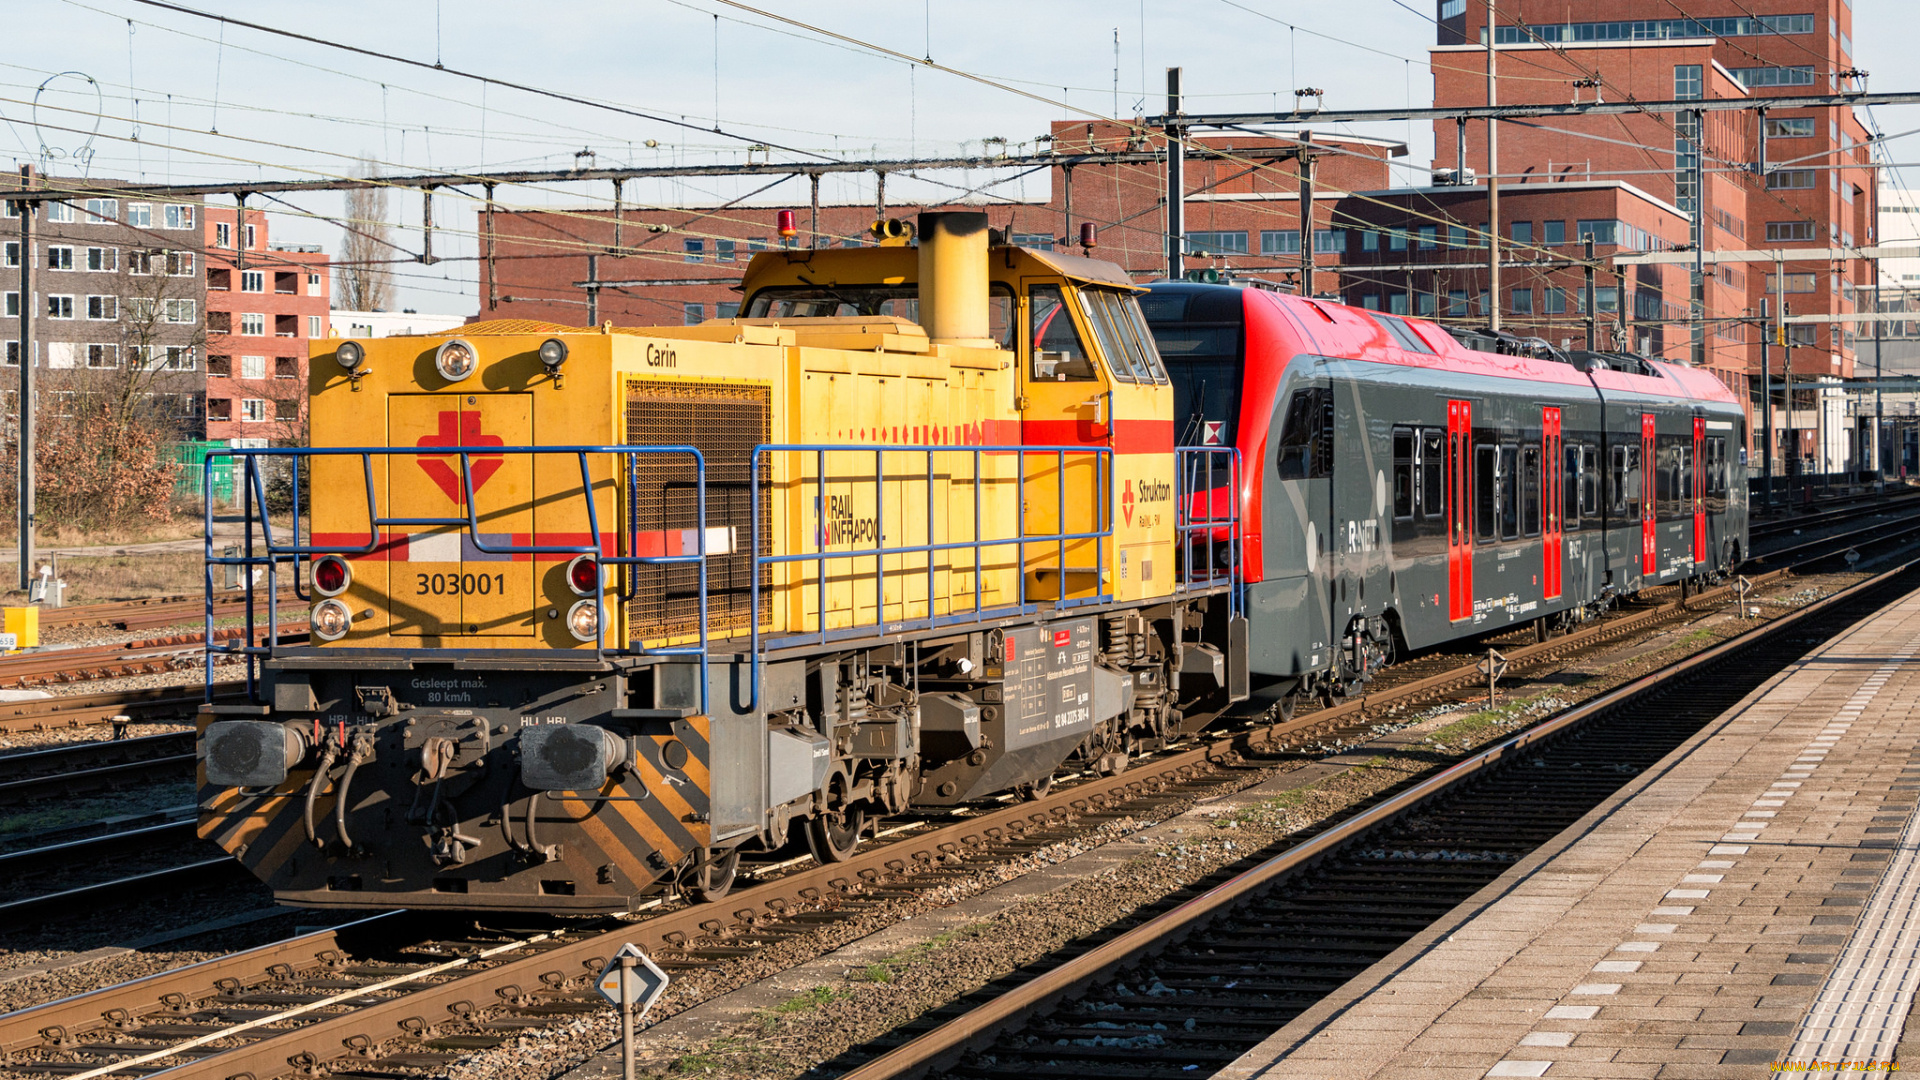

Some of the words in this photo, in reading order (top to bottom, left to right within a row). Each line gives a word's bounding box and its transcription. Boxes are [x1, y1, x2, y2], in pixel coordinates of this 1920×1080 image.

[646, 343, 676, 368] Carin
[1138, 478, 1171, 503] Strukton
[831, 494, 852, 519] RAIL
[831, 518, 886, 545] INFRAPO
[416, 573, 504, 595] 303001
[411, 678, 459, 691] Gesleept
[461, 680, 488, 689] max.
[428, 692, 441, 702] 80
[444, 691, 471, 702] km/h
